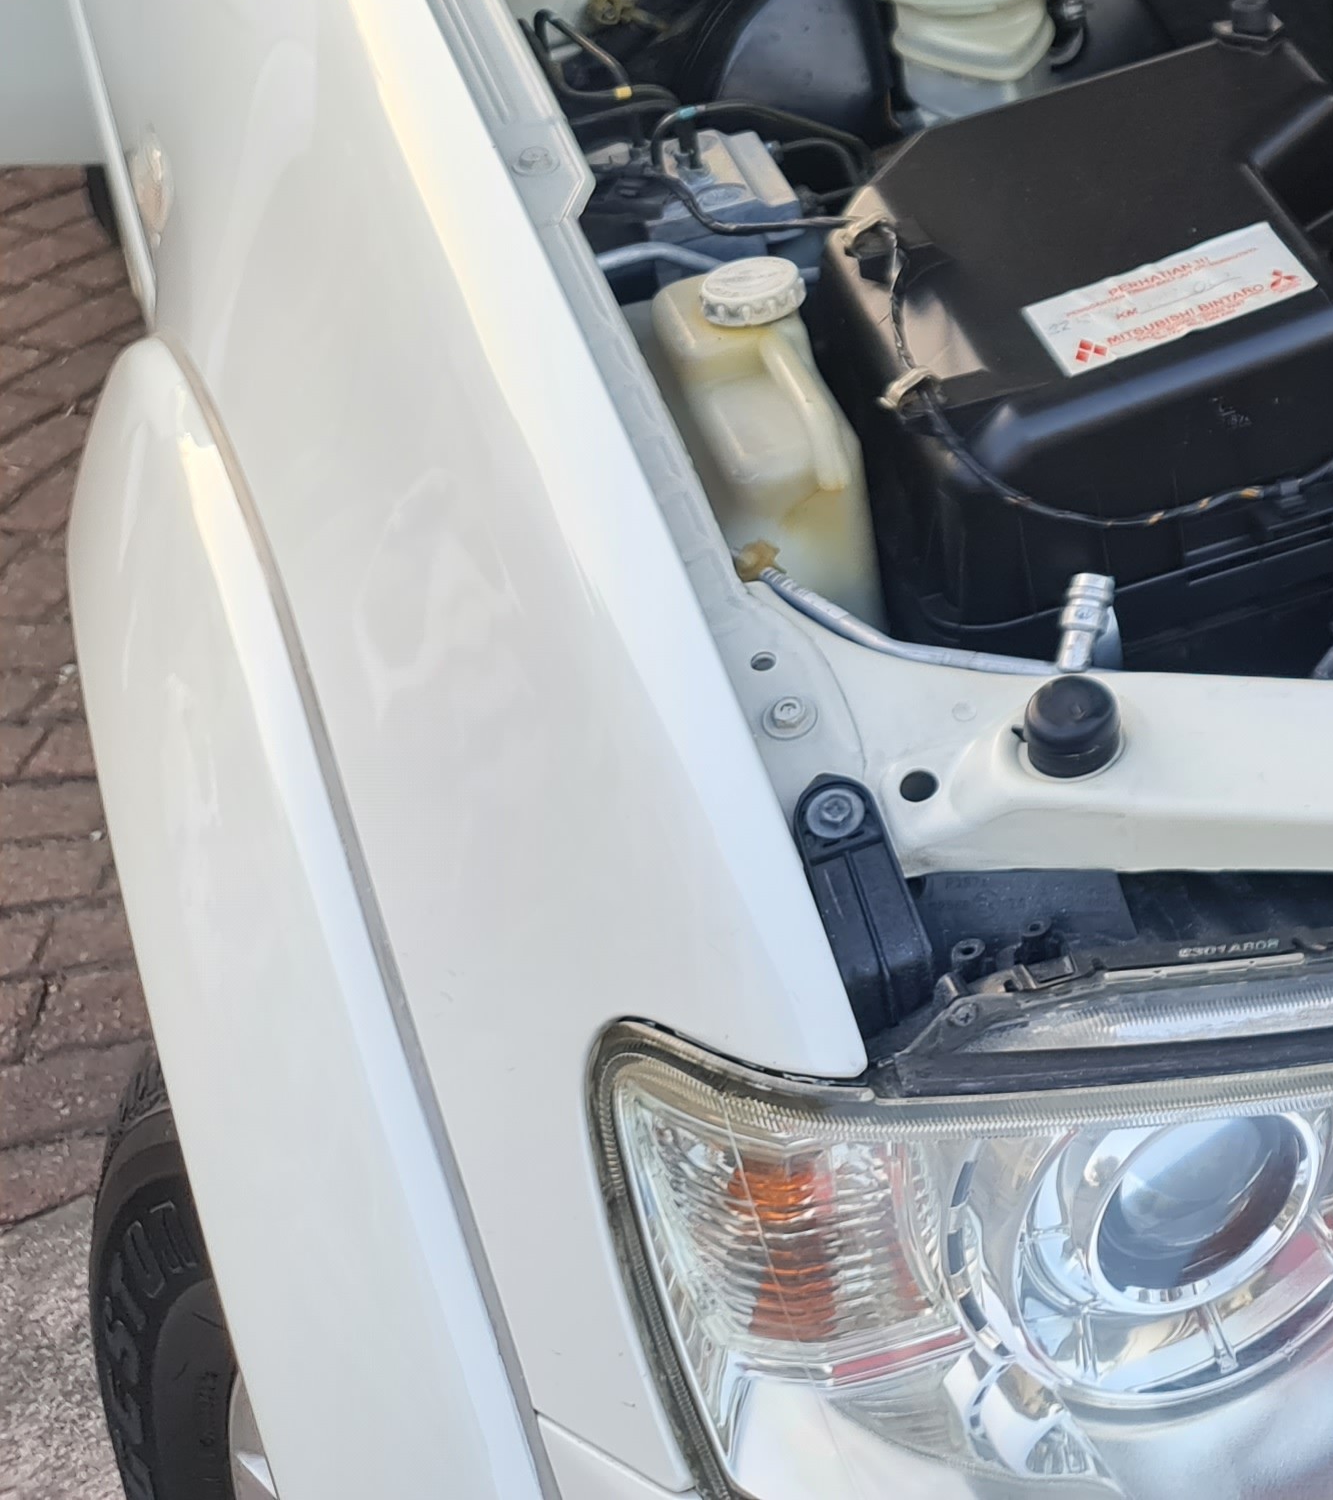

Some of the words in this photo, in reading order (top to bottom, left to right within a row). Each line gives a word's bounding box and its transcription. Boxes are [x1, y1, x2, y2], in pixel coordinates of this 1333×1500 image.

[1107, 259, 1193, 296] PERHATIAN
[1106, 308, 1195, 345] MITSUBISHI
[1197, 283, 1265, 313] BINTARO
[1115, 307, 1138, 321] KM
